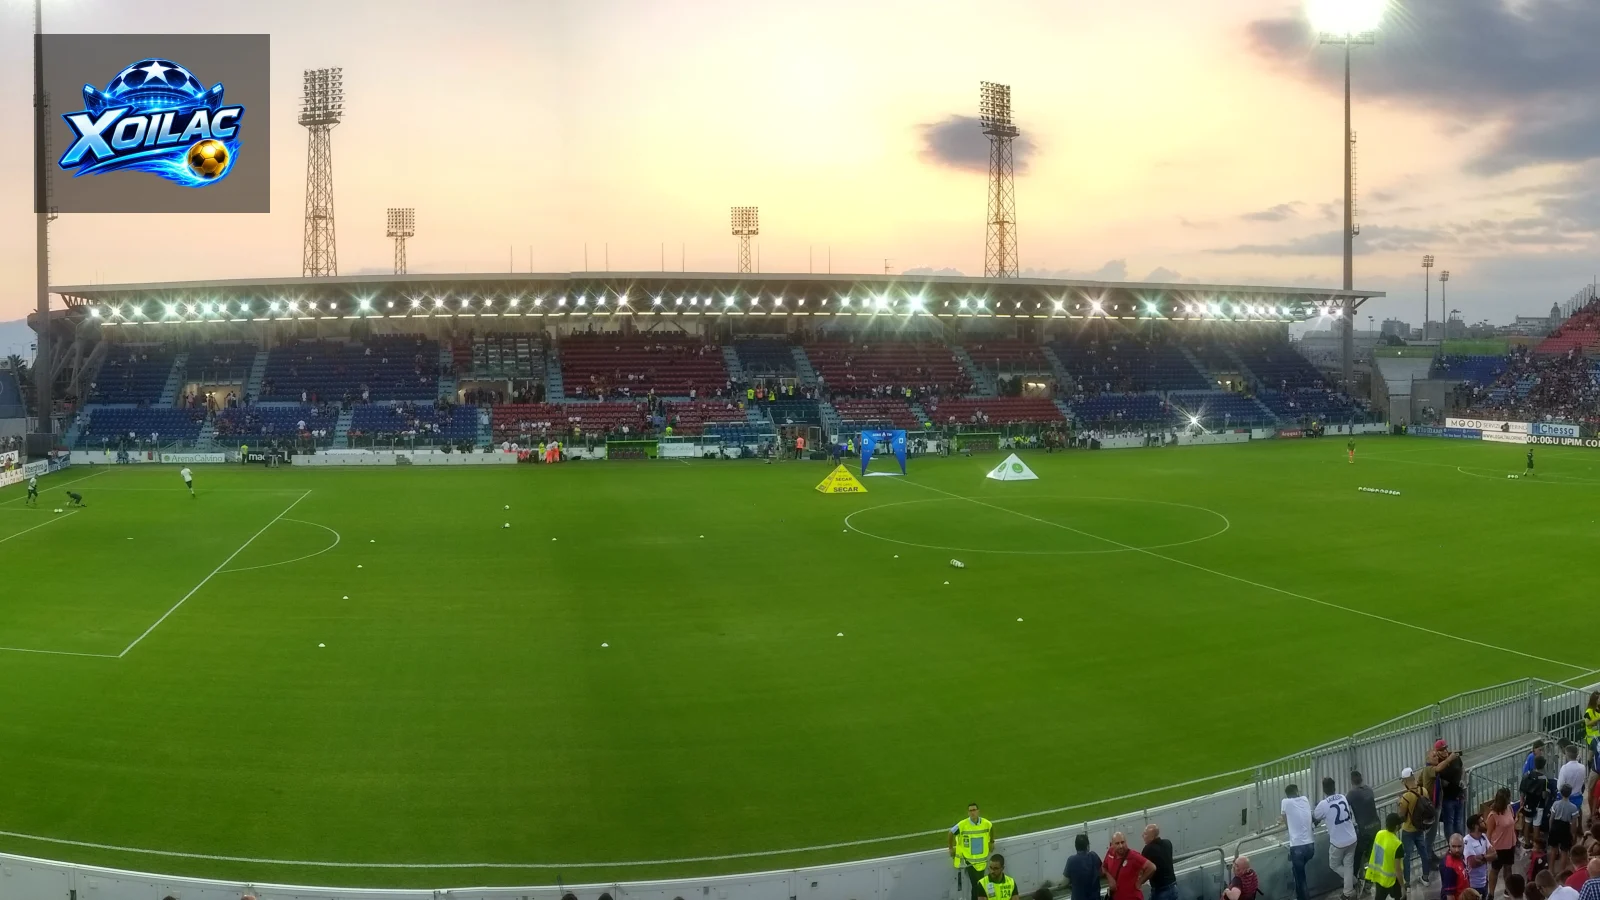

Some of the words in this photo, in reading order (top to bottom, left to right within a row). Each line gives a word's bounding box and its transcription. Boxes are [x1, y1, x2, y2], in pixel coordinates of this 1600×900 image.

[1451, 420, 1482, 429] MOOD
[1541, 425, 1574, 436] Chessa
[1330, 801, 1350, 825] 23
[1000, 889, 1011, 899] 124
